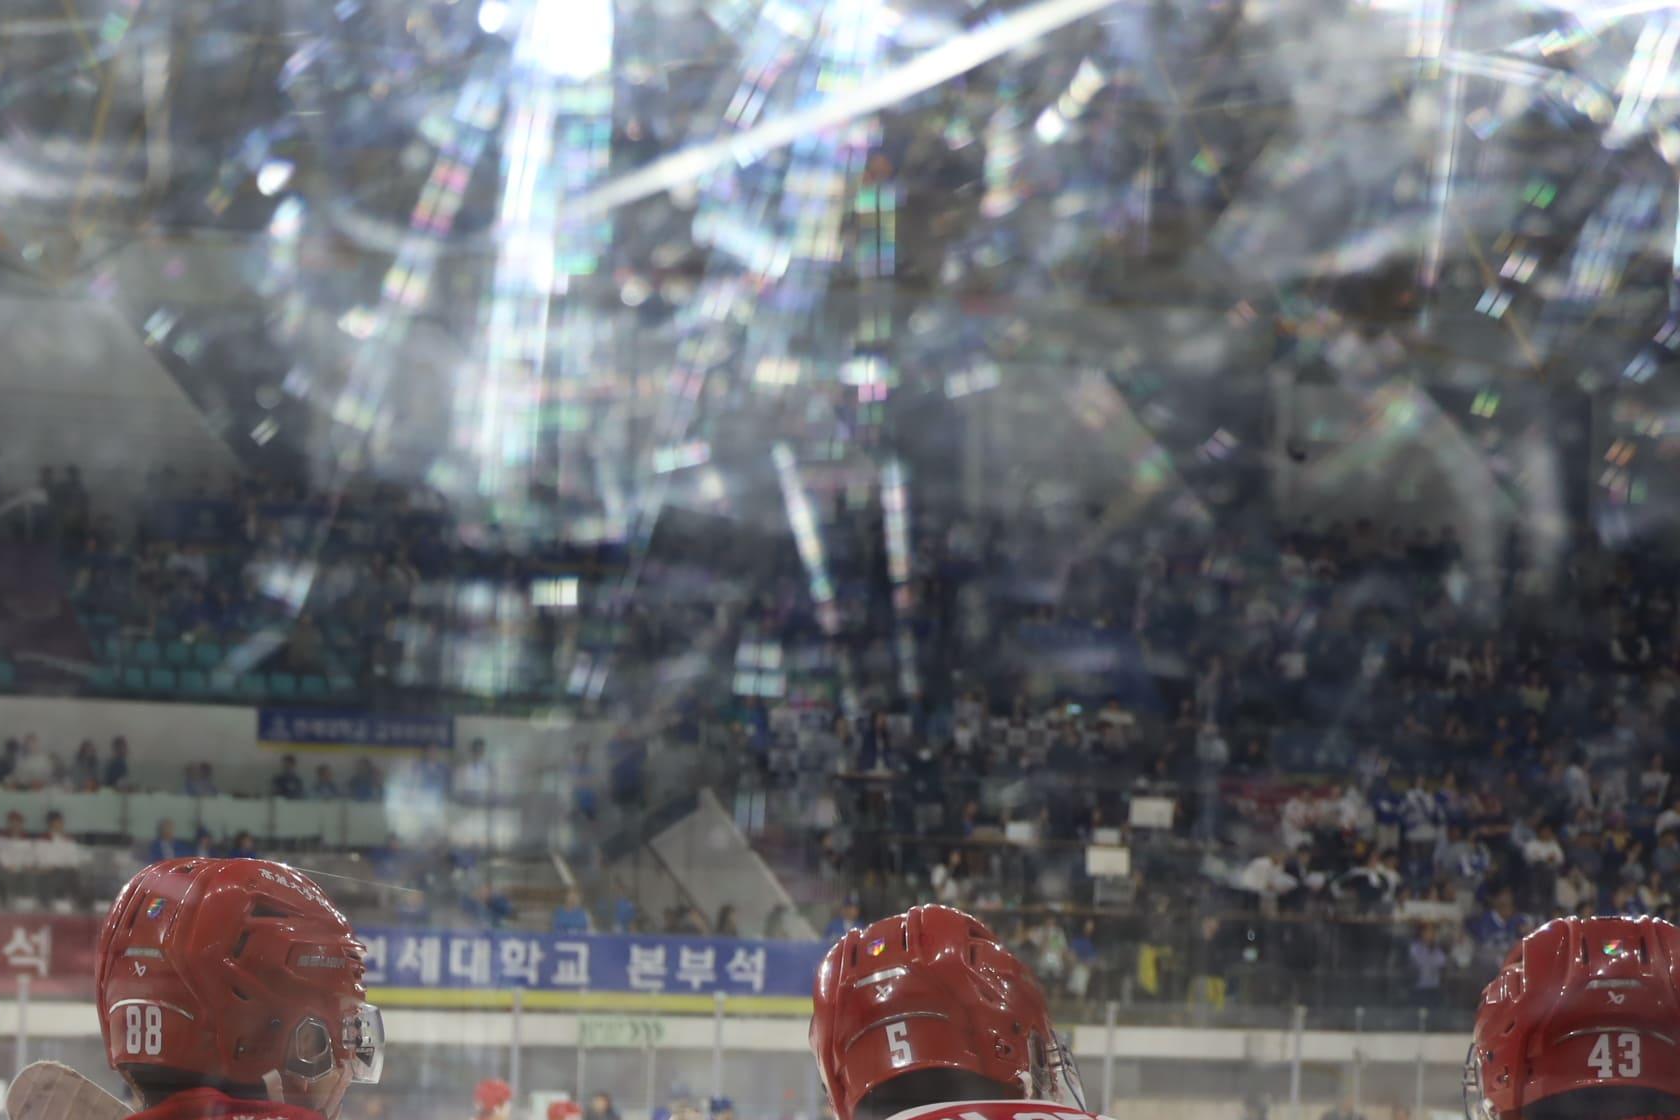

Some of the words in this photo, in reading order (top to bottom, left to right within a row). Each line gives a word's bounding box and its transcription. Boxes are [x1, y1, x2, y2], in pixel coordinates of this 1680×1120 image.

[627, 943, 766, 993] 본부석
[125, 1005, 163, 1056] 88
[885, 1020, 914, 1068] 5
[1587, 1033, 1641, 1079] 43
